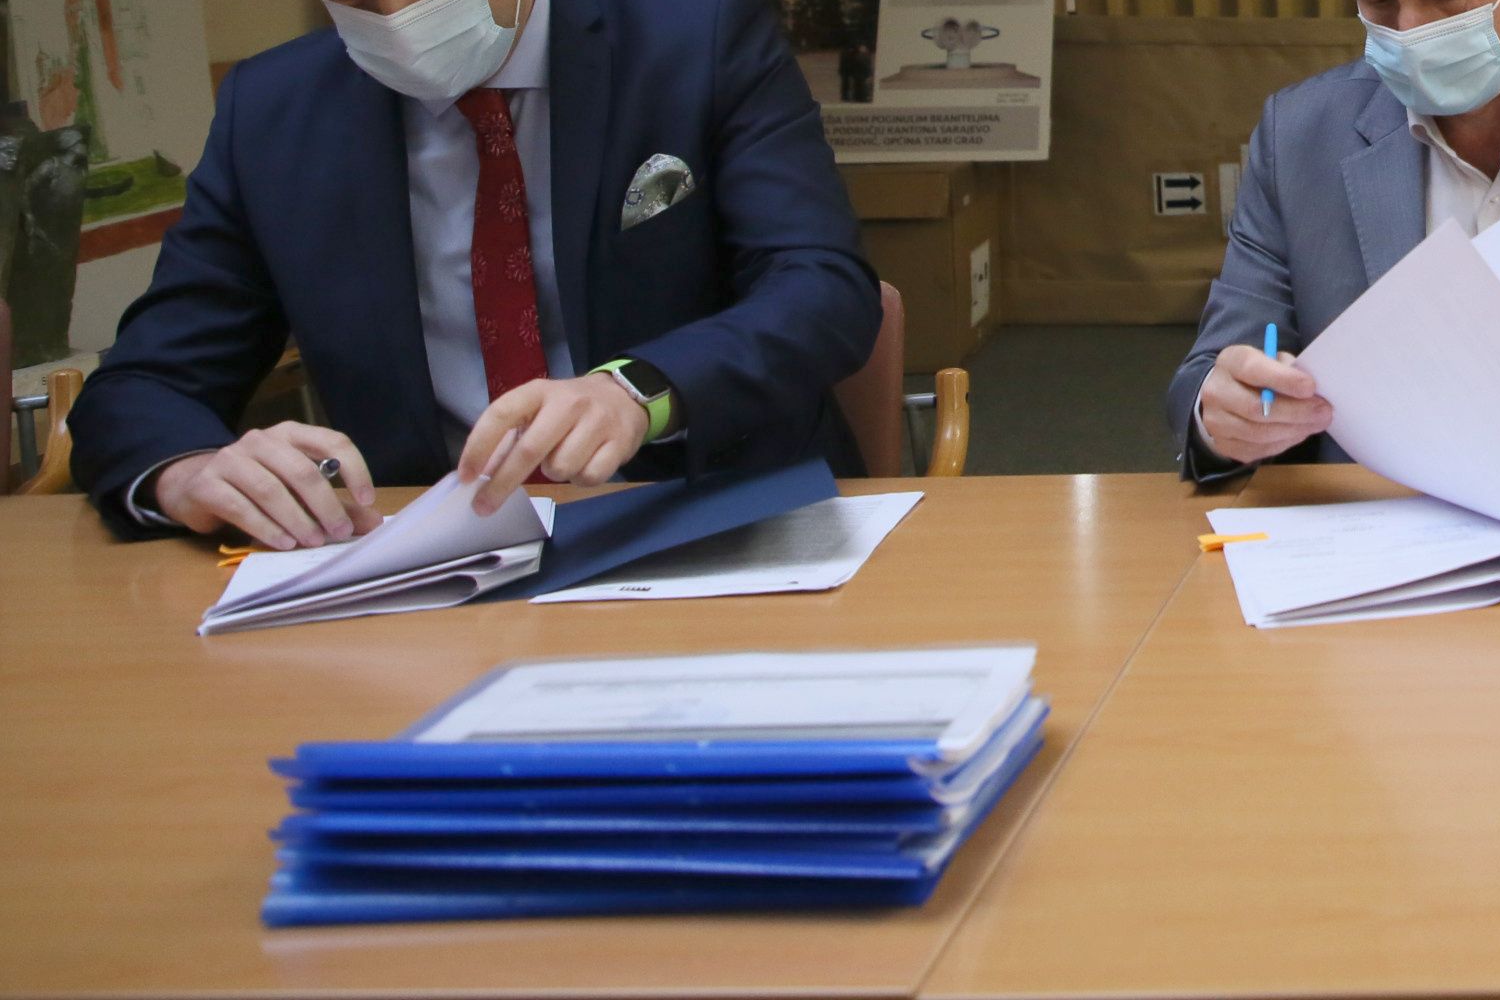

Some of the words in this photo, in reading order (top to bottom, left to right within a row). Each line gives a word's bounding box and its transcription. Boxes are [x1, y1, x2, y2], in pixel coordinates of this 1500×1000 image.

[871, 114, 927, 124] POGINULIM
[930, 113, 1000, 123] BRANITELJIMA
[887, 126, 938, 135] KANTONA
[940, 125, 991, 135] SARAJEVO
[923, 136, 952, 145] STARI
[954, 135, 984, 145] GRAD
